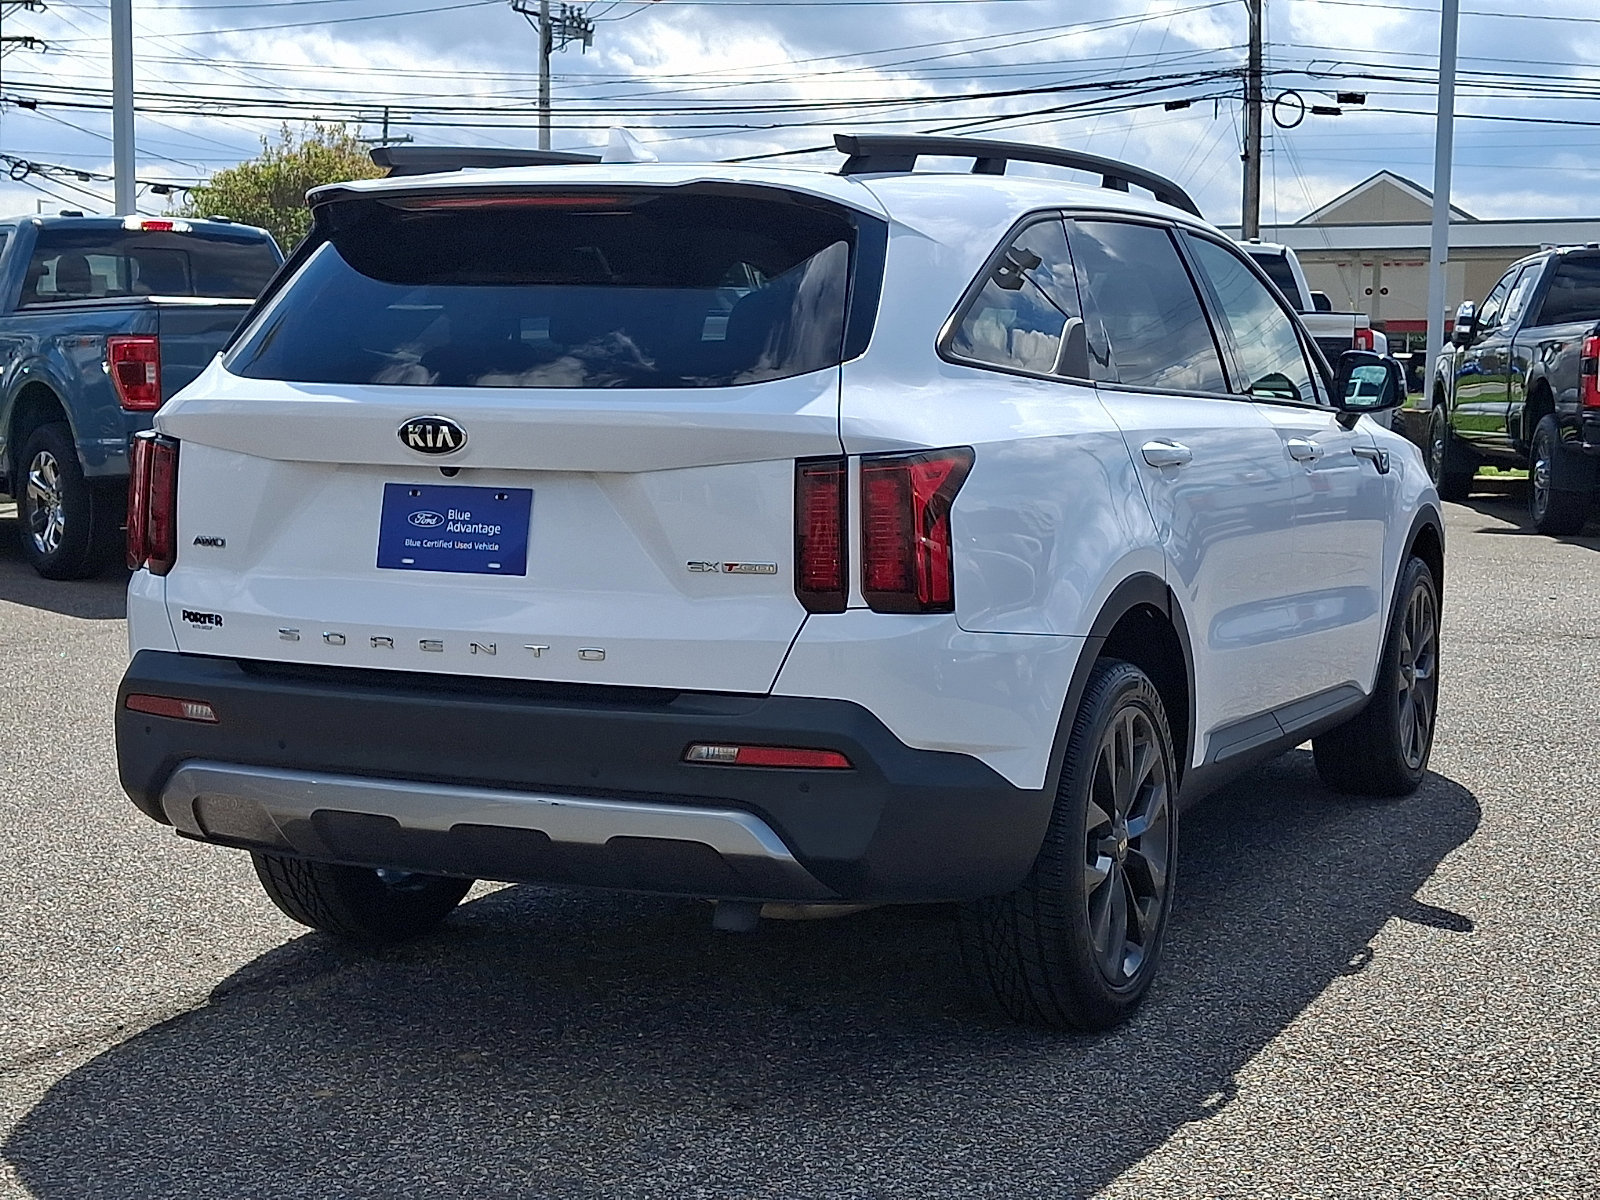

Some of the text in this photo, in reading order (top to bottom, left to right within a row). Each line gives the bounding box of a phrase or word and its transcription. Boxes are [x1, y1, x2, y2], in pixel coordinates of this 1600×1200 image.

[408, 425, 455, 447] KIA
[414, 513, 438, 526] Ford
[448, 509, 471, 521] Blue
[446, 521, 502, 536] Advantage
[193, 535, 226, 548] AWD
[405, 538, 500, 551] Blue Certified Used Vehicle
[687, 561, 720, 573] EX
[182, 609, 224, 627] PORTER
[278, 627, 606, 662] SORENTO
